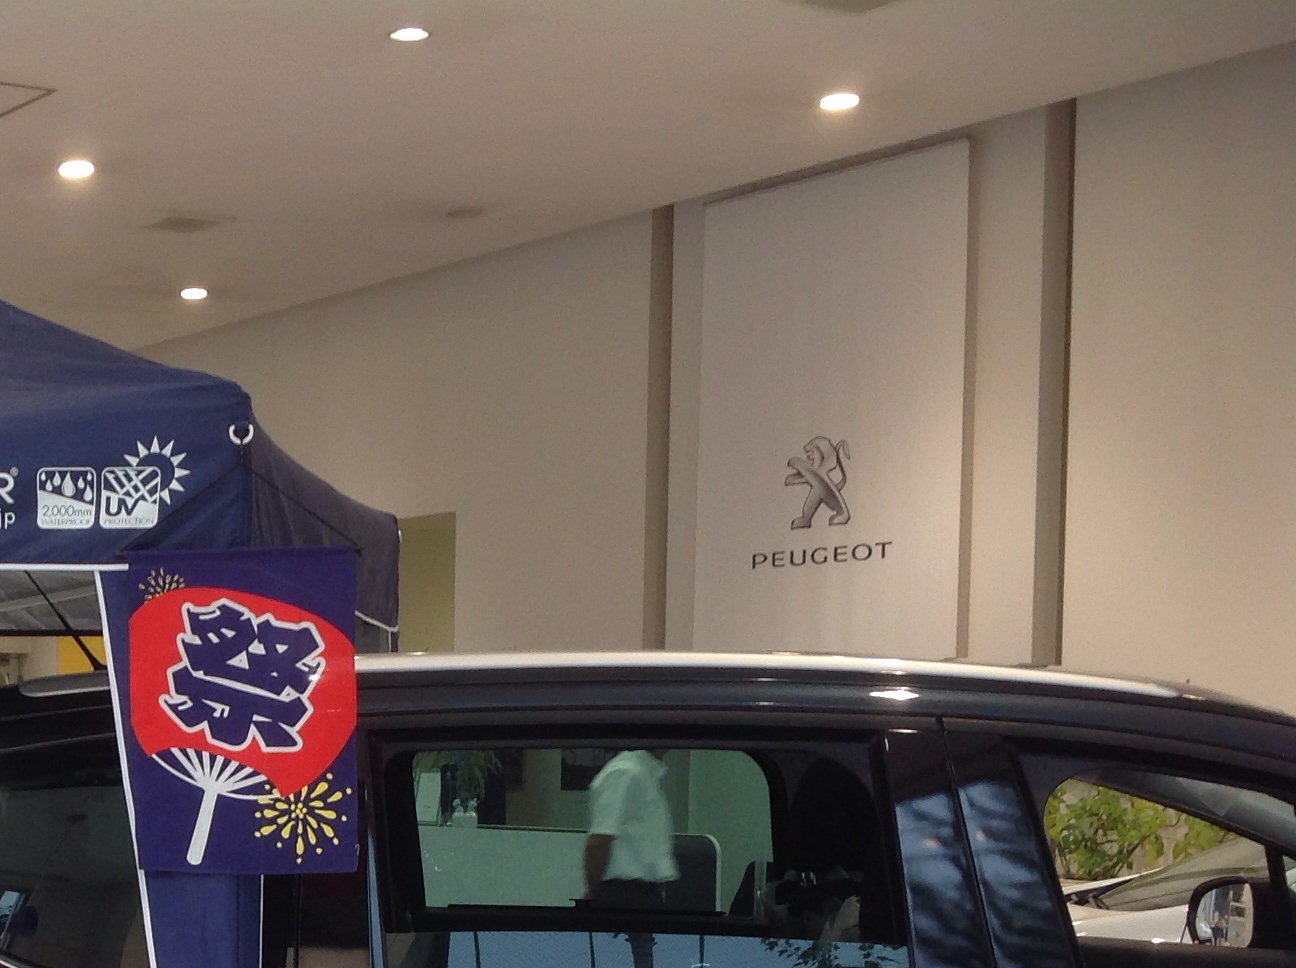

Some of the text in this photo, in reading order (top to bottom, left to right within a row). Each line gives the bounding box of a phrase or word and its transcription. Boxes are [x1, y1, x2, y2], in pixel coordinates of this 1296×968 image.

[42, 504, 92, 517] 2,000mm
[105, 496, 140, 516] UV
[751, 541, 893, 570] PEUGEOT
[158, 598, 326, 752] 祭
